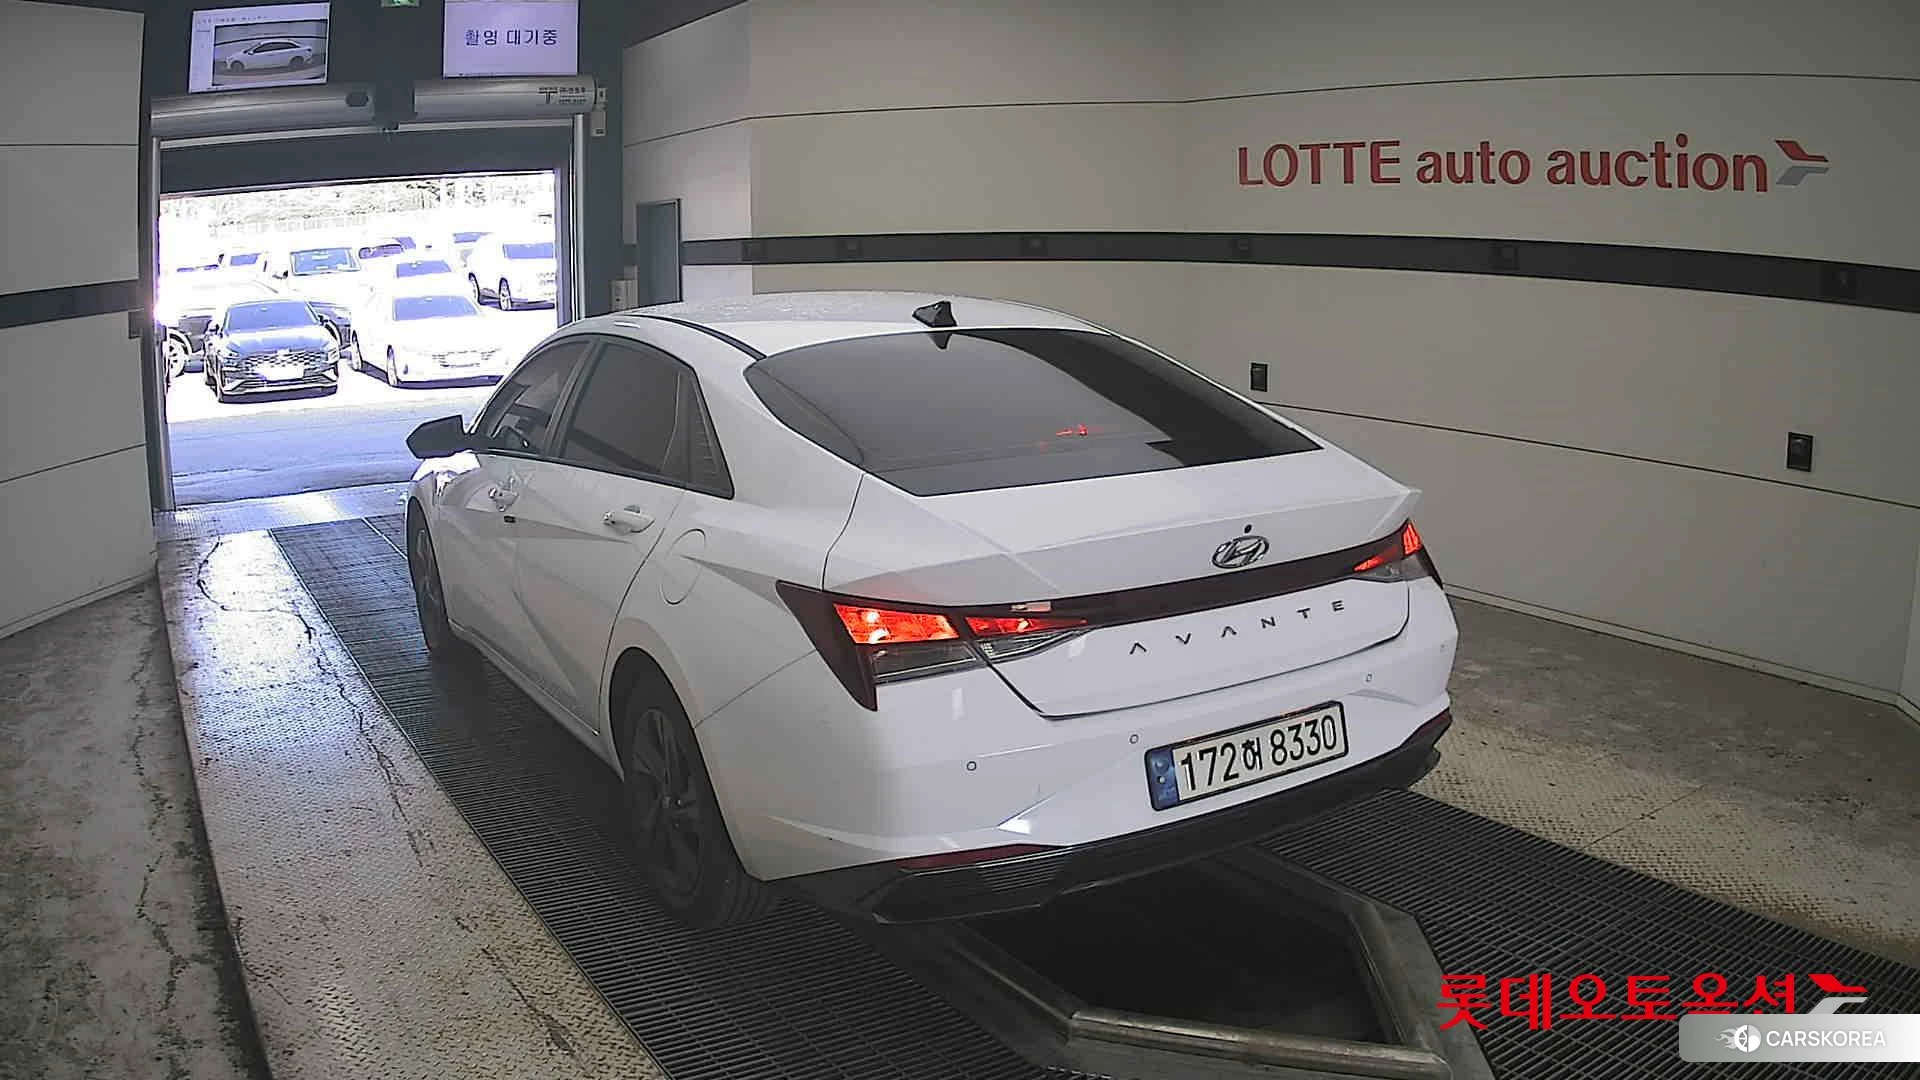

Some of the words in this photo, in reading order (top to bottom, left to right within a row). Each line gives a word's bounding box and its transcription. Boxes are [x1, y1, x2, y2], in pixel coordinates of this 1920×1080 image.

[506, 29, 557, 46] 대기중
[1238, 141, 1401, 186] LOTTE
[1416, 141, 1531, 185] auto
[1547, 133, 1769, 193] auction
[1129, 600, 1345, 655] AVANTE
[1180, 737, 1264, 791] 172허
[1270, 715, 1337, 766] 8330
